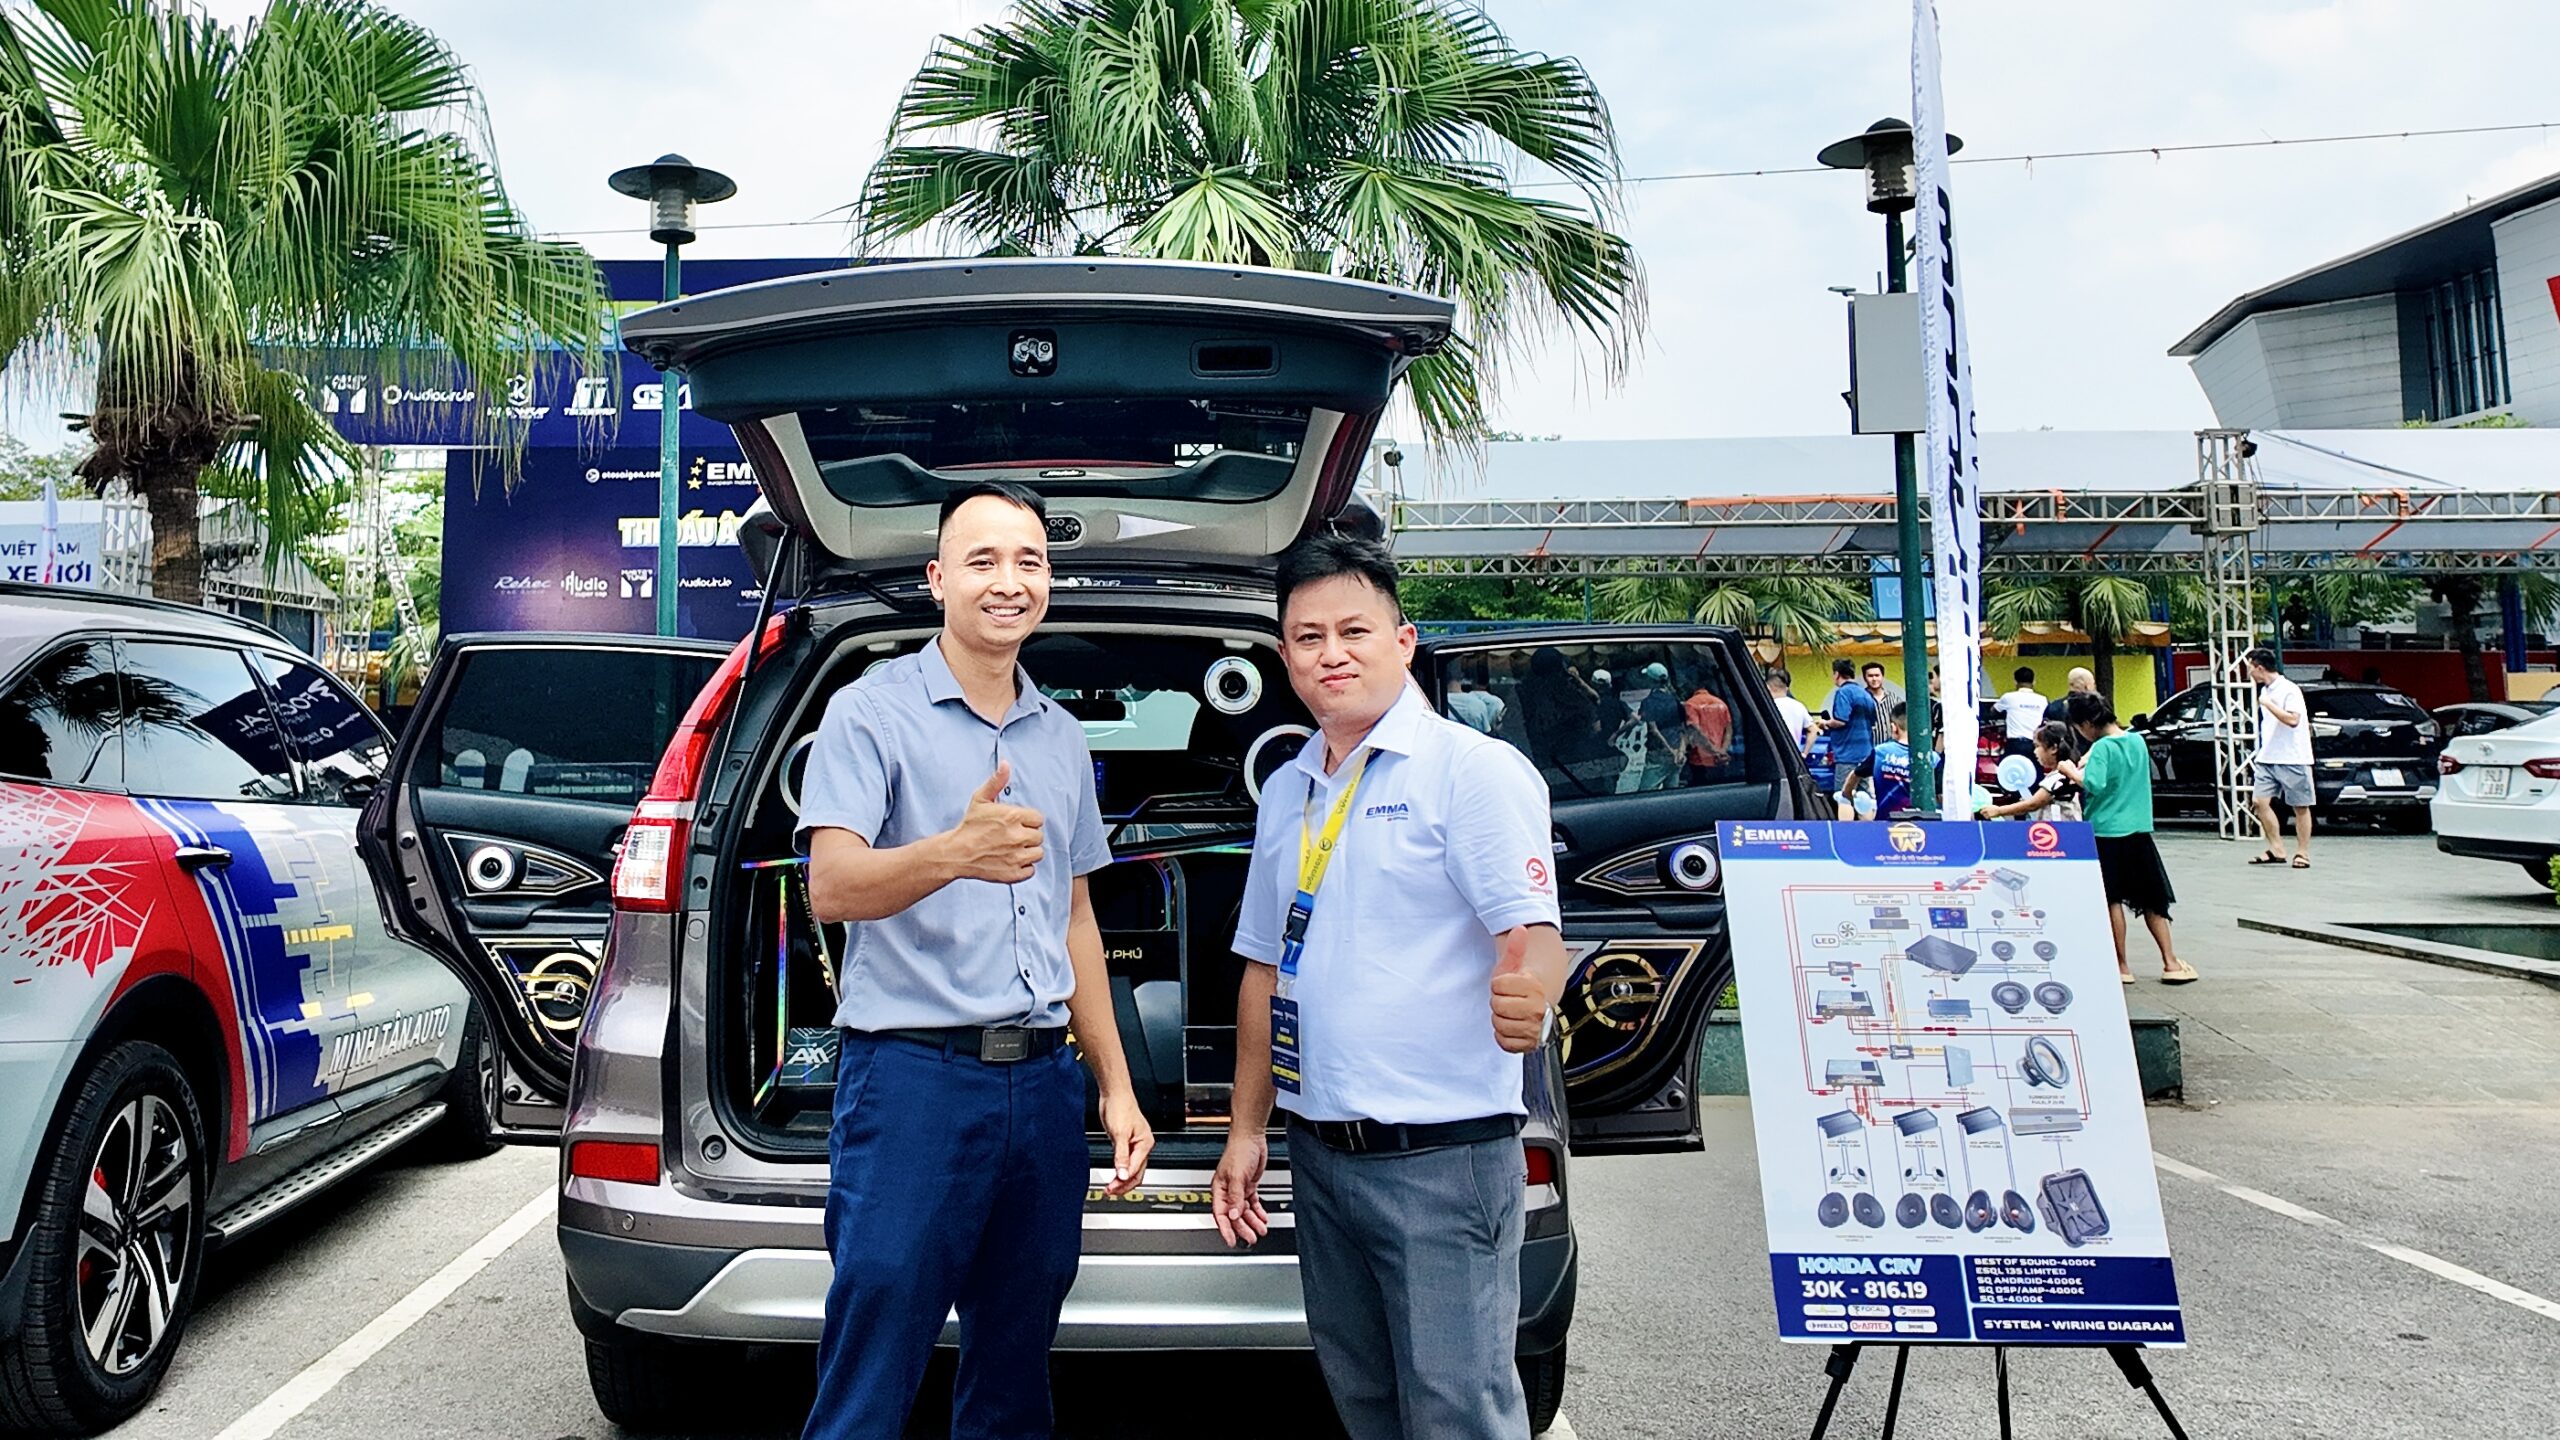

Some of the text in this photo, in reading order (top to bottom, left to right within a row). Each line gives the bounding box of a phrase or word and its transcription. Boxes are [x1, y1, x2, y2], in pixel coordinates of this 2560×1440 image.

[0, 539, 37, 560] VIỆT
[7, 565, 38, 583] XE
[1365, 803, 1409, 816] EMMA
[1744, 829, 1810, 841] EMMA
[1815, 937, 1837, 945] LED
[1112, 947, 1143, 960] PHÚ
[328, 1003, 451, 1077] MINH TÂN AUTO
[1798, 1256, 1923, 1276] HONDA CRV
[1974, 1258, 2002, 1266] BEST
[2003, 1258, 2018, 1266] OF
[2024, 1268, 2067, 1276] LIMITED
[1977, 1276, 1994, 1286] SQ
[1801, 1280, 1847, 1299] 30K
[1863, 1281, 1928, 1299] 816.19
[1978, 1286, 1995, 1295] SQ
[1980, 1295, 1995, 1304] SQ
[1983, 1319, 2042, 1330] SYSTEM
[2051, 1320, 2105, 1331] WIRING
[2107, 1321, 2175, 1332] DIAGRAM
